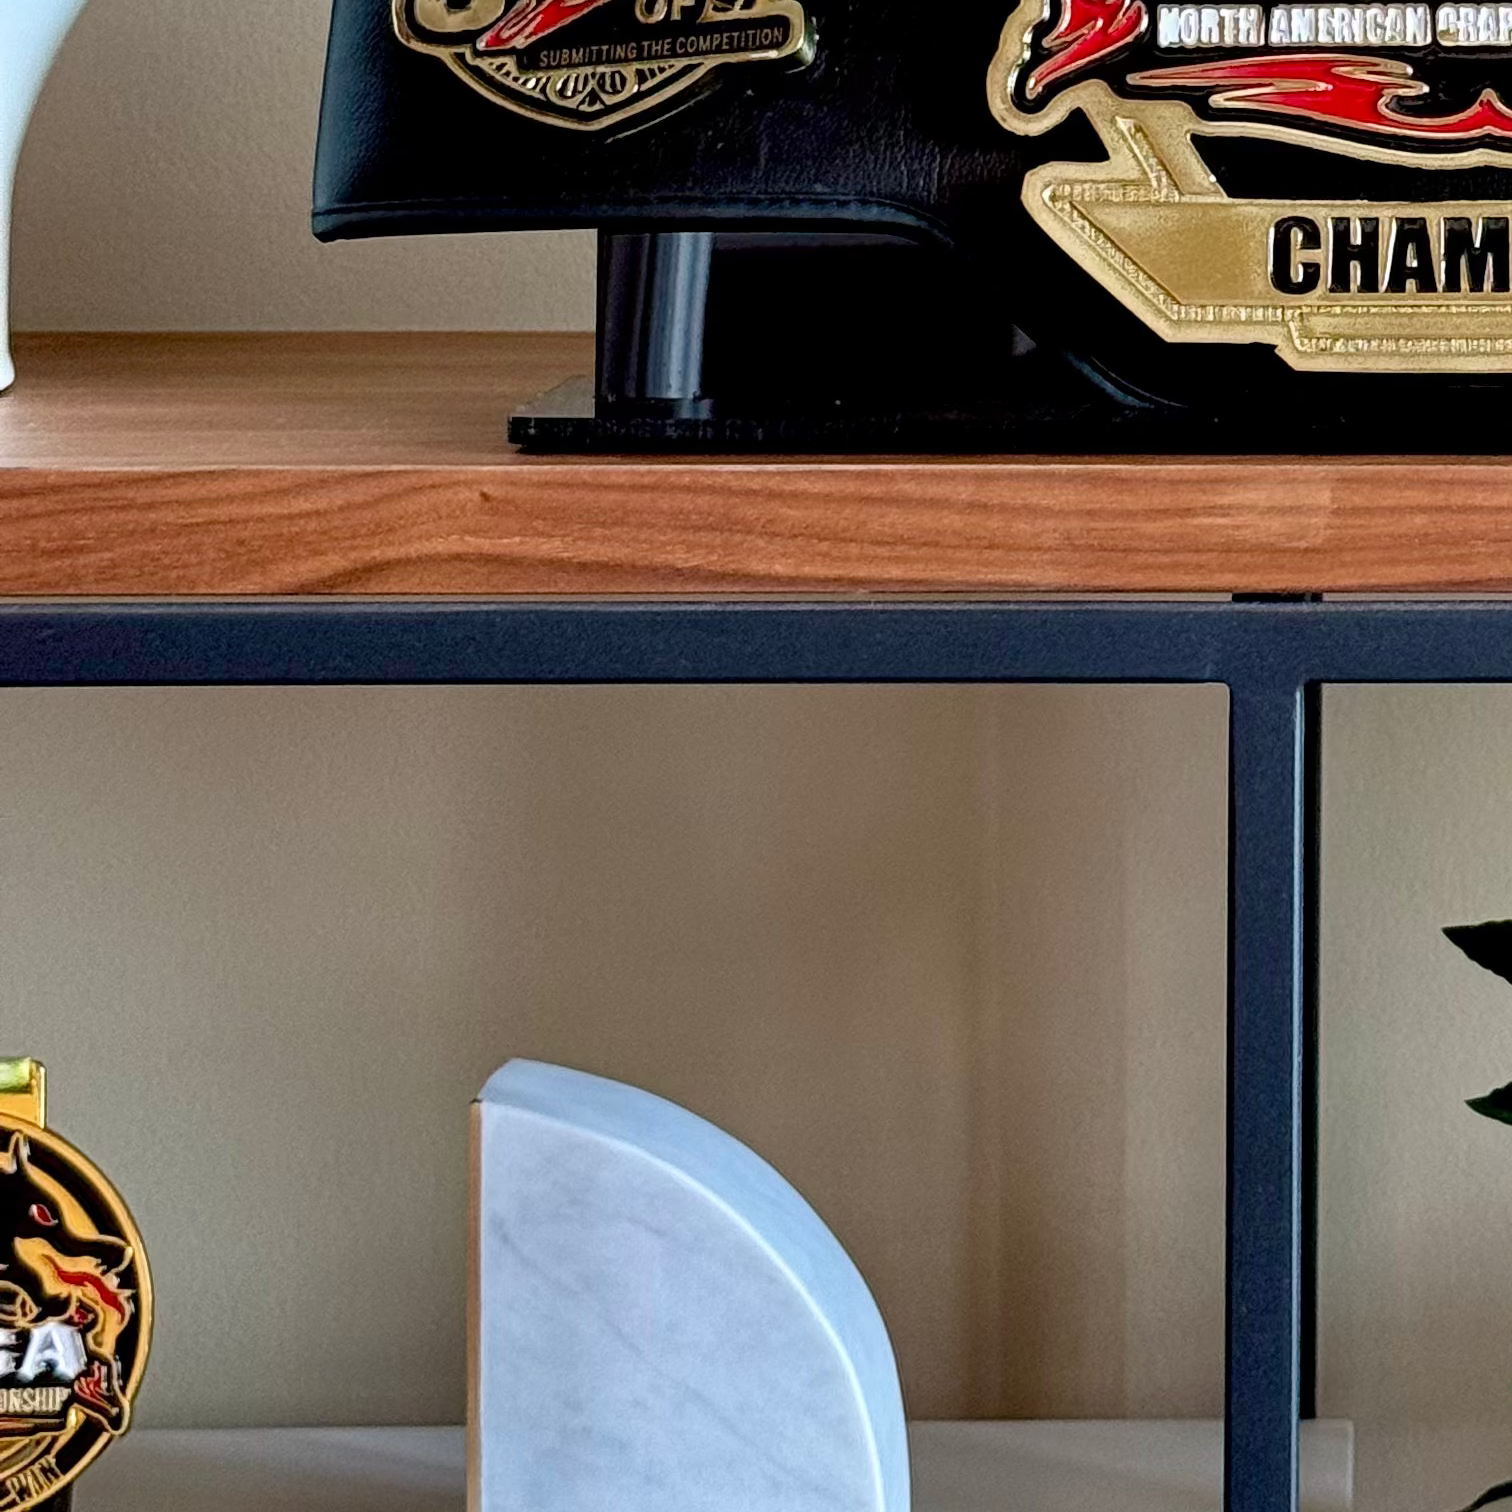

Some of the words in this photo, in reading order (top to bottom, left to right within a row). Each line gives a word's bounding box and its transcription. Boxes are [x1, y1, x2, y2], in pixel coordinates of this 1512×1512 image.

[1157, 3, 1265, 47] NORTH
[1268, 3, 1432, 47] AMERICAN
[539, 42, 638, 67] SUBMITTING
[641, 38, 672, 56] THE
[675, 27, 783, 54] COMPETITION
